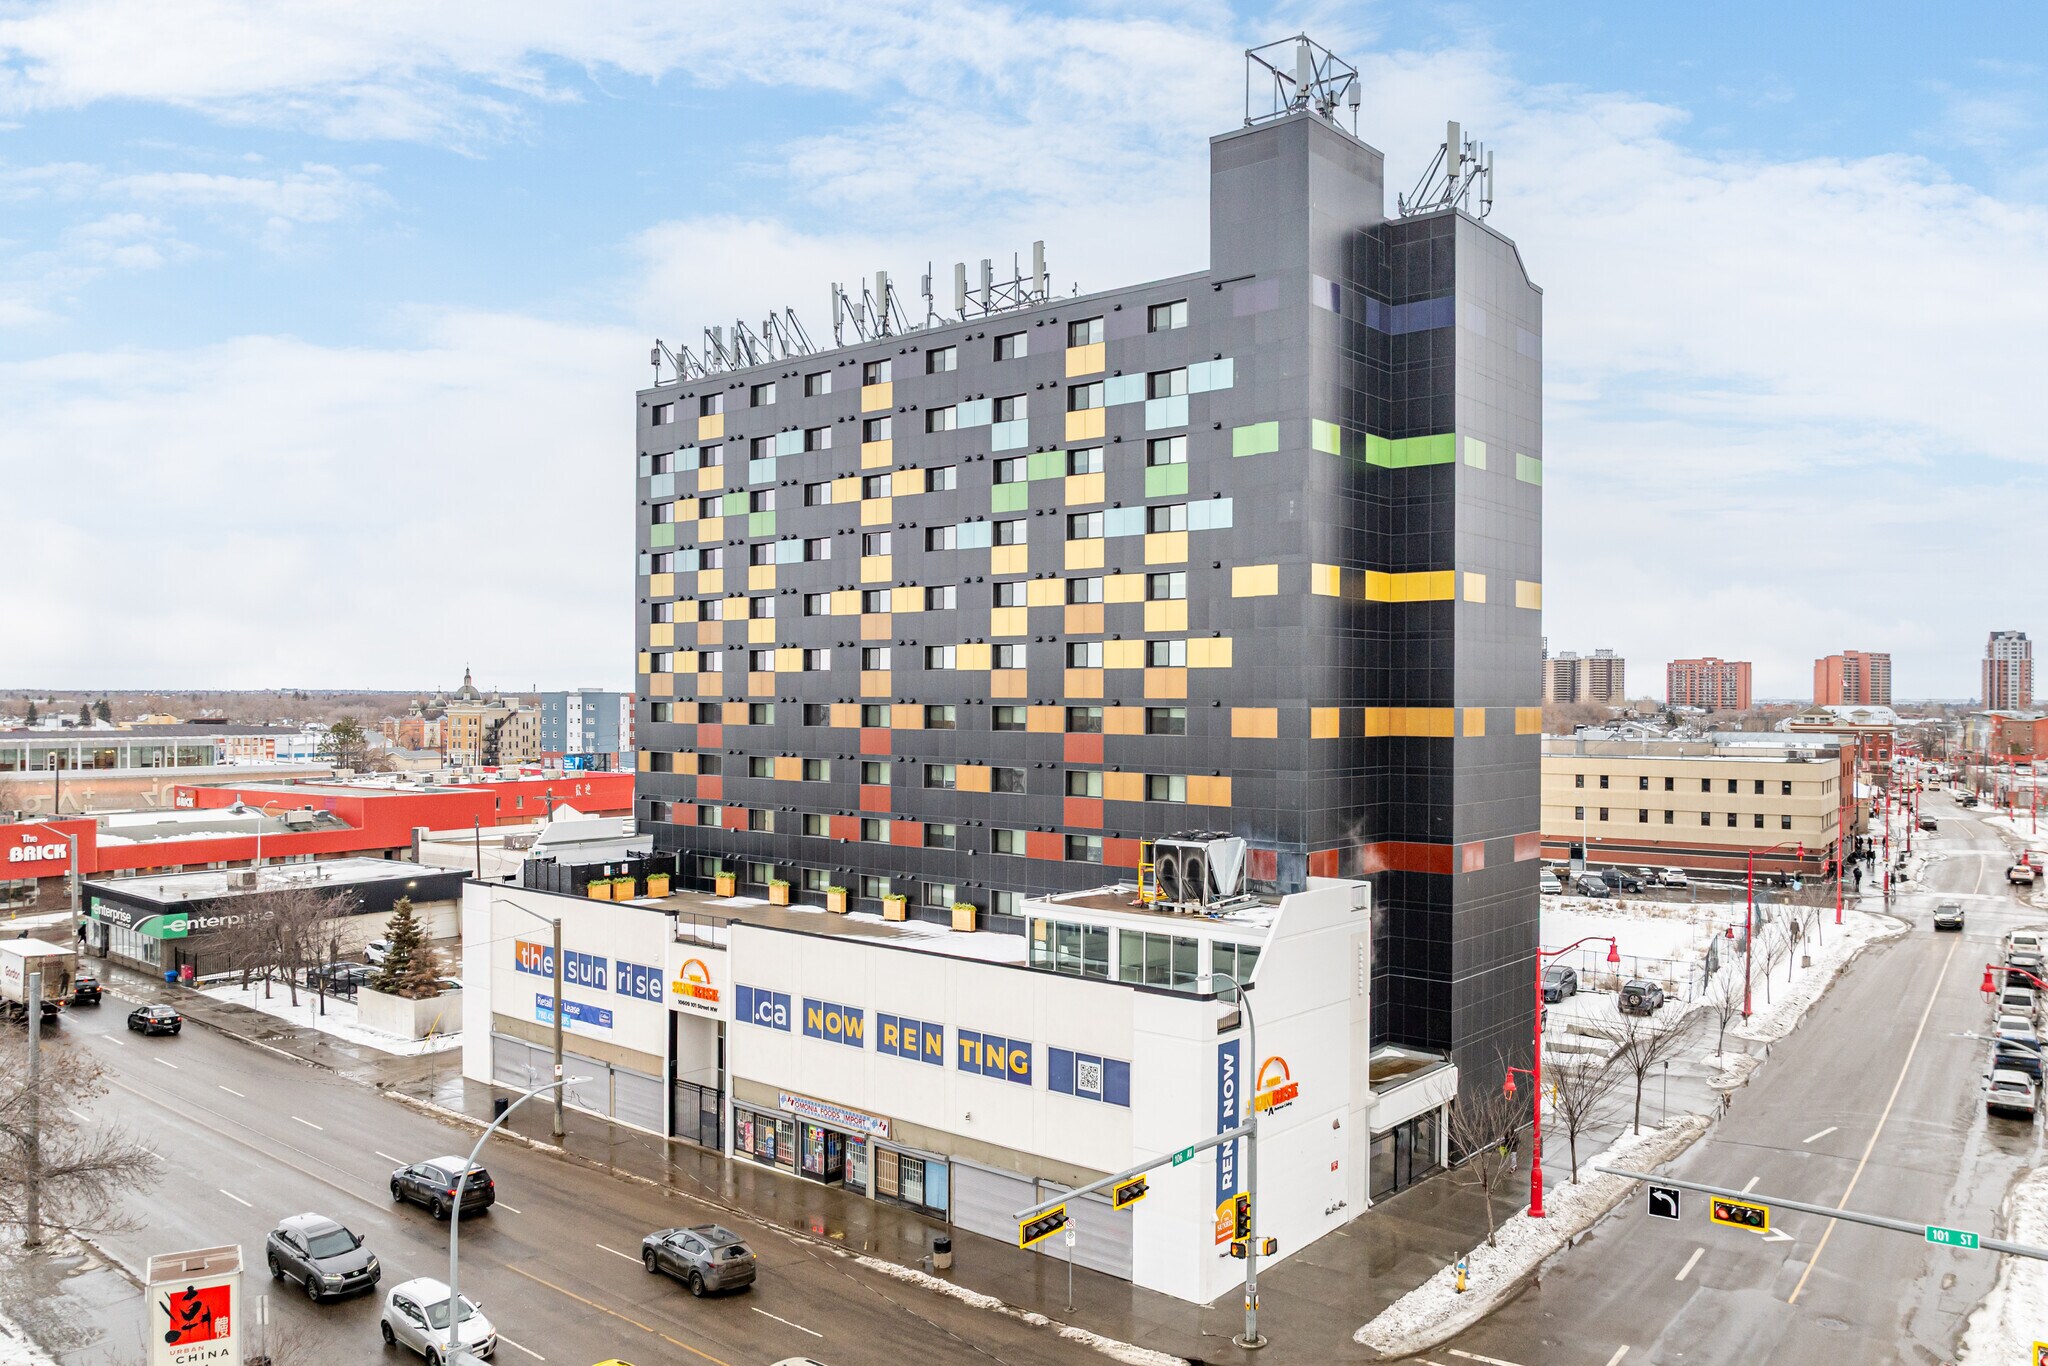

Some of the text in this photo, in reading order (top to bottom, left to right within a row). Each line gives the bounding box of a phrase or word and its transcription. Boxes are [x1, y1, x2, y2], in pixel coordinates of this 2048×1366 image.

[21, 834, 38, 843] The
[10, 844, 67, 862] BRICK
[91, 903, 132, 924] enterprise
[521, 946, 662, 998] the sun rise
[537, 995, 553, 1008] Retail
[564, 1002, 580, 1015] Lease
[755, 1001, 787, 1026] .ca
[807, 1007, 863, 1039] NOW
[1223, 1053, 1234, 1118] NOW
[794, 1101, 818, 1113] OMONIA
[820, 1107, 841, 1119] FOODS
[1174, 1152, 1183, 1164] 106
[1217, 1219, 1233, 1232] SUNRIS
[1932, 1229, 1973, 1246] 101 ST
[169, 1345, 205, 1356] URBAN
[176, 1348, 229, 1364] CHINA
